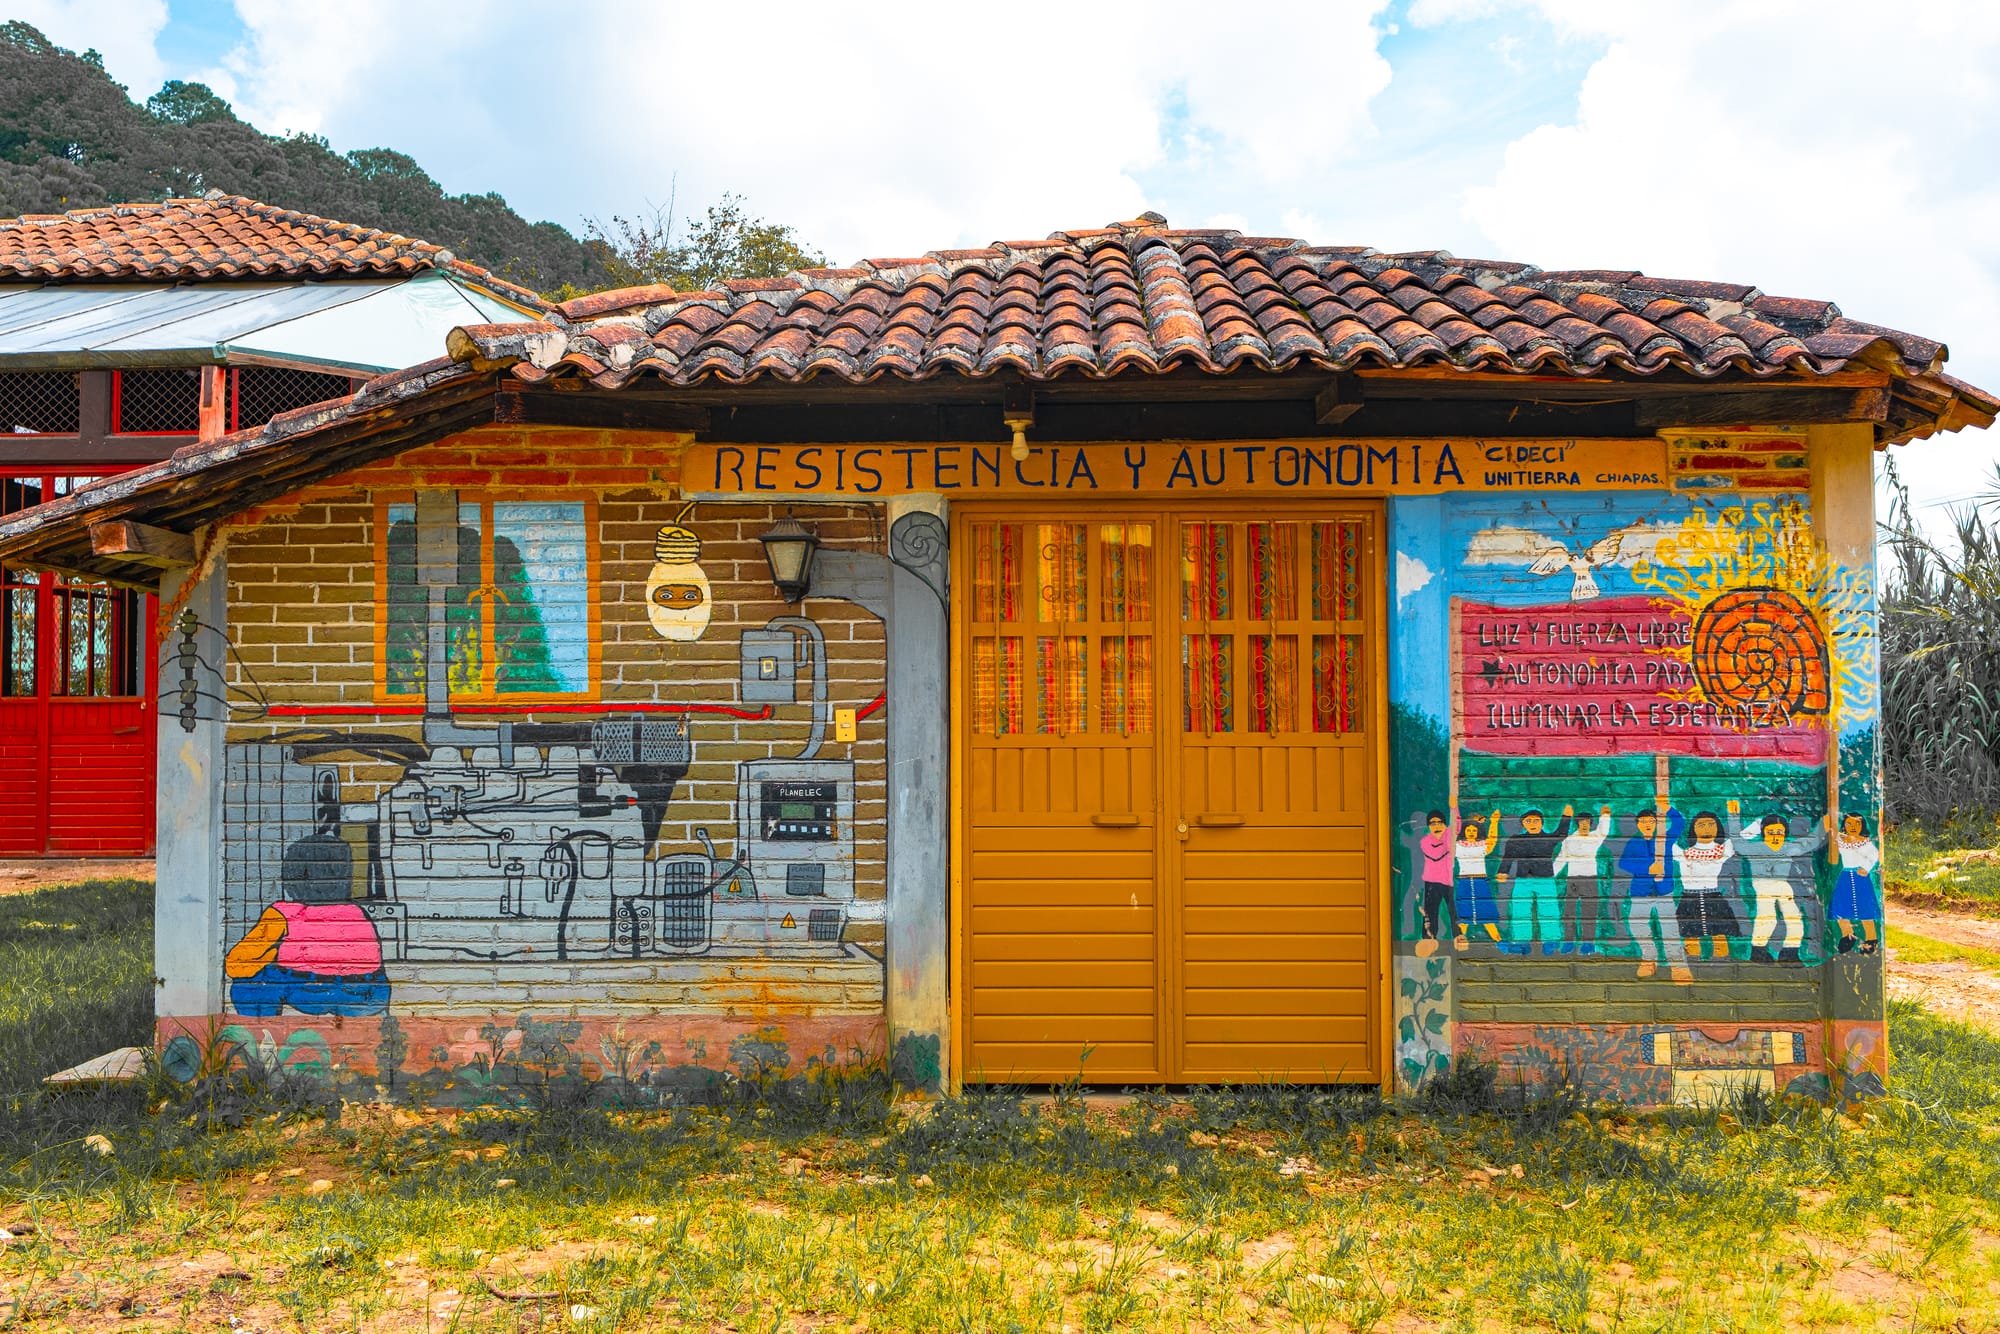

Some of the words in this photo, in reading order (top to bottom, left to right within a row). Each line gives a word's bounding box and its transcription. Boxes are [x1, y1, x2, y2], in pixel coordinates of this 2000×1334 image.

[714, 446, 1098, 493] RESISTENCIA
[1124, 446, 1146, 490] Y
[1166, 443, 1465, 488] AUTONOMIA
[1484, 470, 1581, 486] UNITIERRA
[1478, 622, 1521, 647] LUZ
[1528, 621, 1541, 646] Y
[1547, 622, 1631, 647] FUERZA
[1636, 621, 1692, 647] LIBRE
[1504, 660, 1638, 686] AUTONOMIA
[1645, 661, 1698, 686] PARA
[1486, 702, 1602, 729] ILUMINAR
[1610, 702, 1640, 727] LA
[1648, 702, 1793, 728] ESPERANZA
[779, 787, 822, 797] PLANELEC
